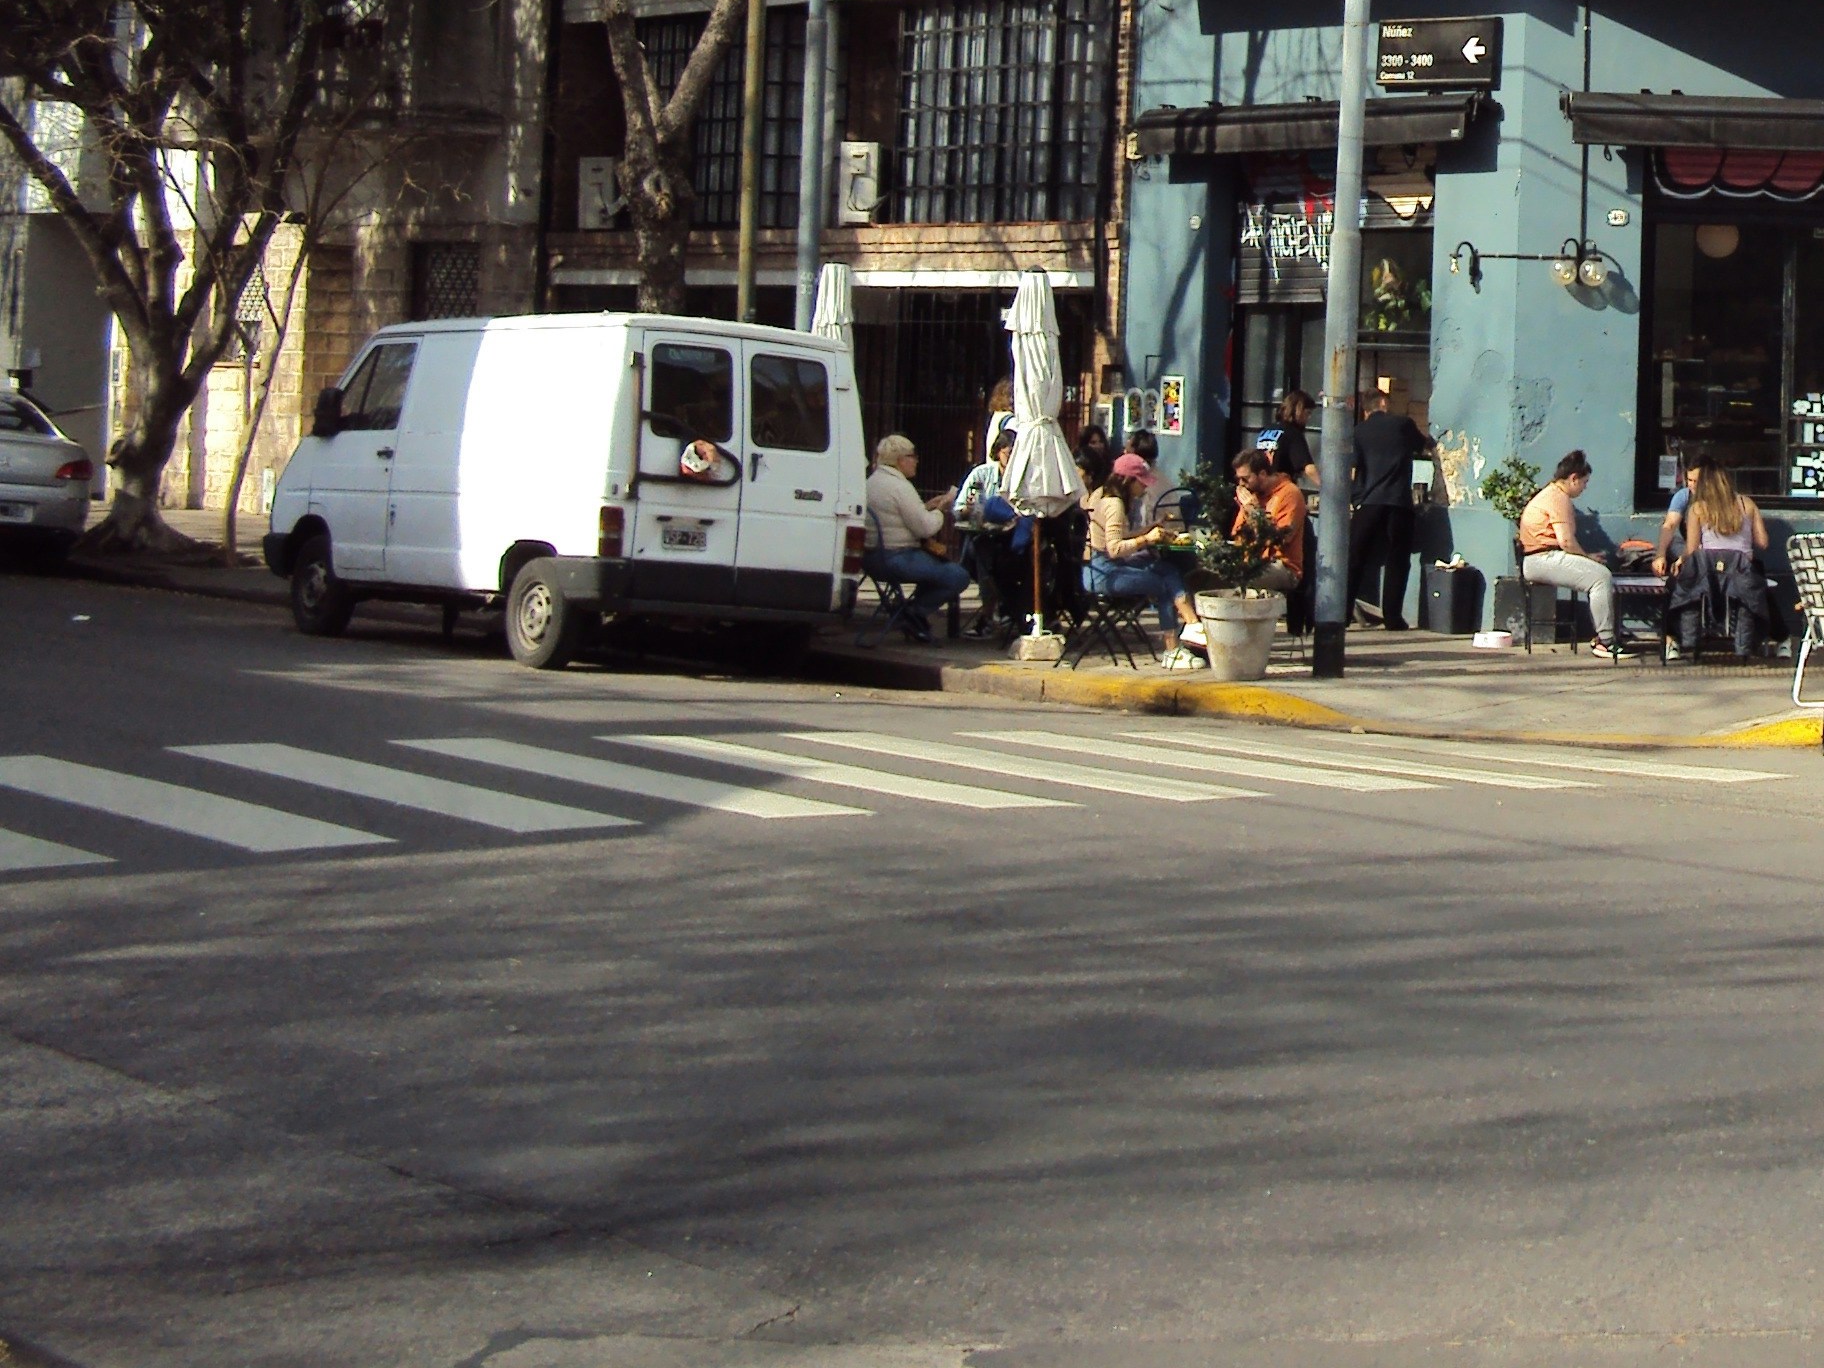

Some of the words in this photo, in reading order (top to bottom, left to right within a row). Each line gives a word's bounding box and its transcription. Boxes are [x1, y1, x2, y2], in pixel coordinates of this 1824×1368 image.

[1382, 25, 1414, 38] Núñez
[1381, 54, 1404, 67] 3300
[1410, 53, 1434, 67] 3400
